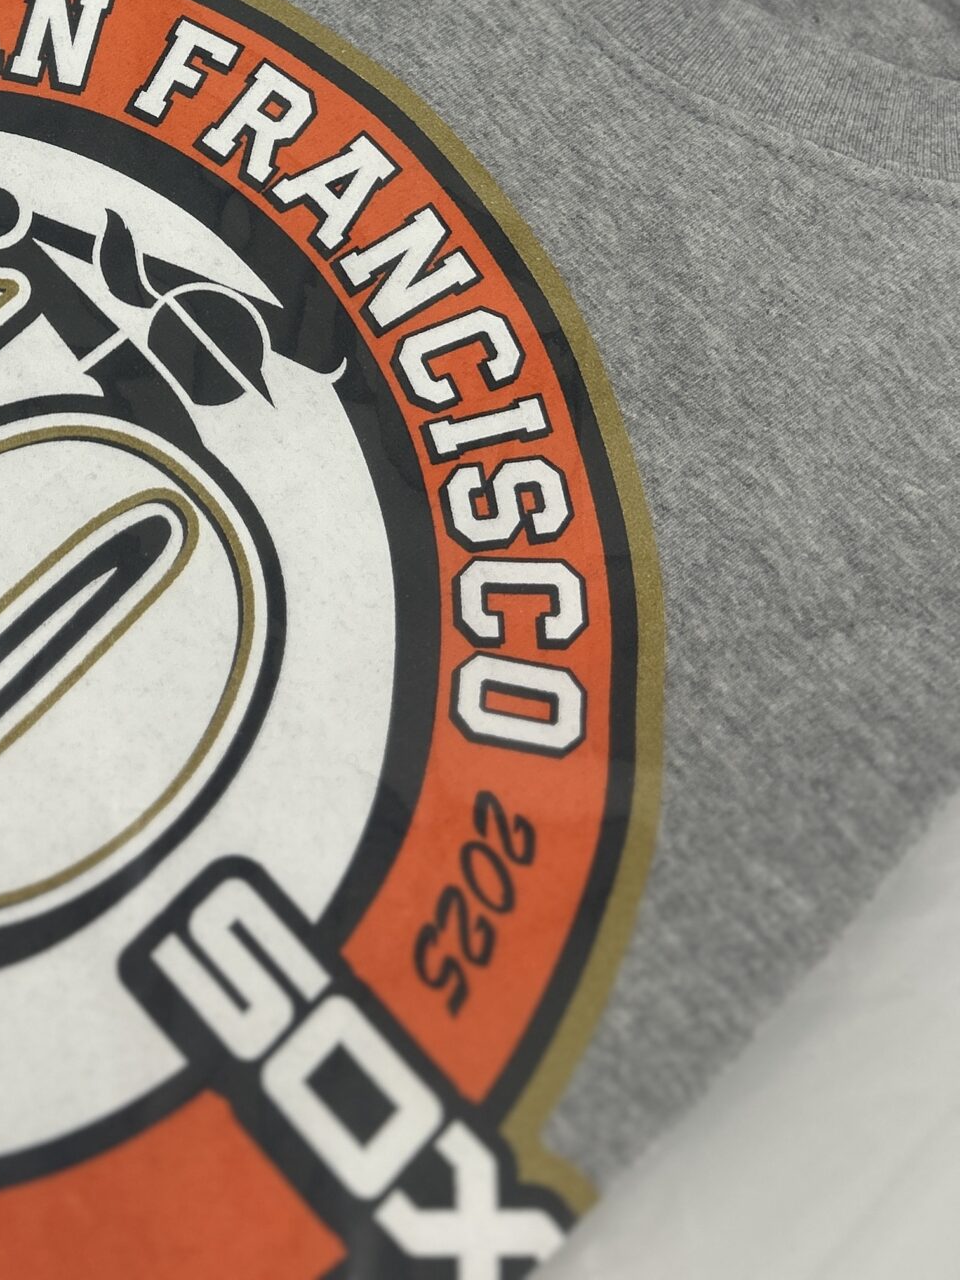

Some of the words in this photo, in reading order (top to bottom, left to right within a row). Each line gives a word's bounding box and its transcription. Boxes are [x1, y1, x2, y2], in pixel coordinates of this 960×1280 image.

[133, 18, 588, 760] FRANCISCO
[150, 877, 567, 1280] SOX
[413, 789, 537, 1019] 2025
